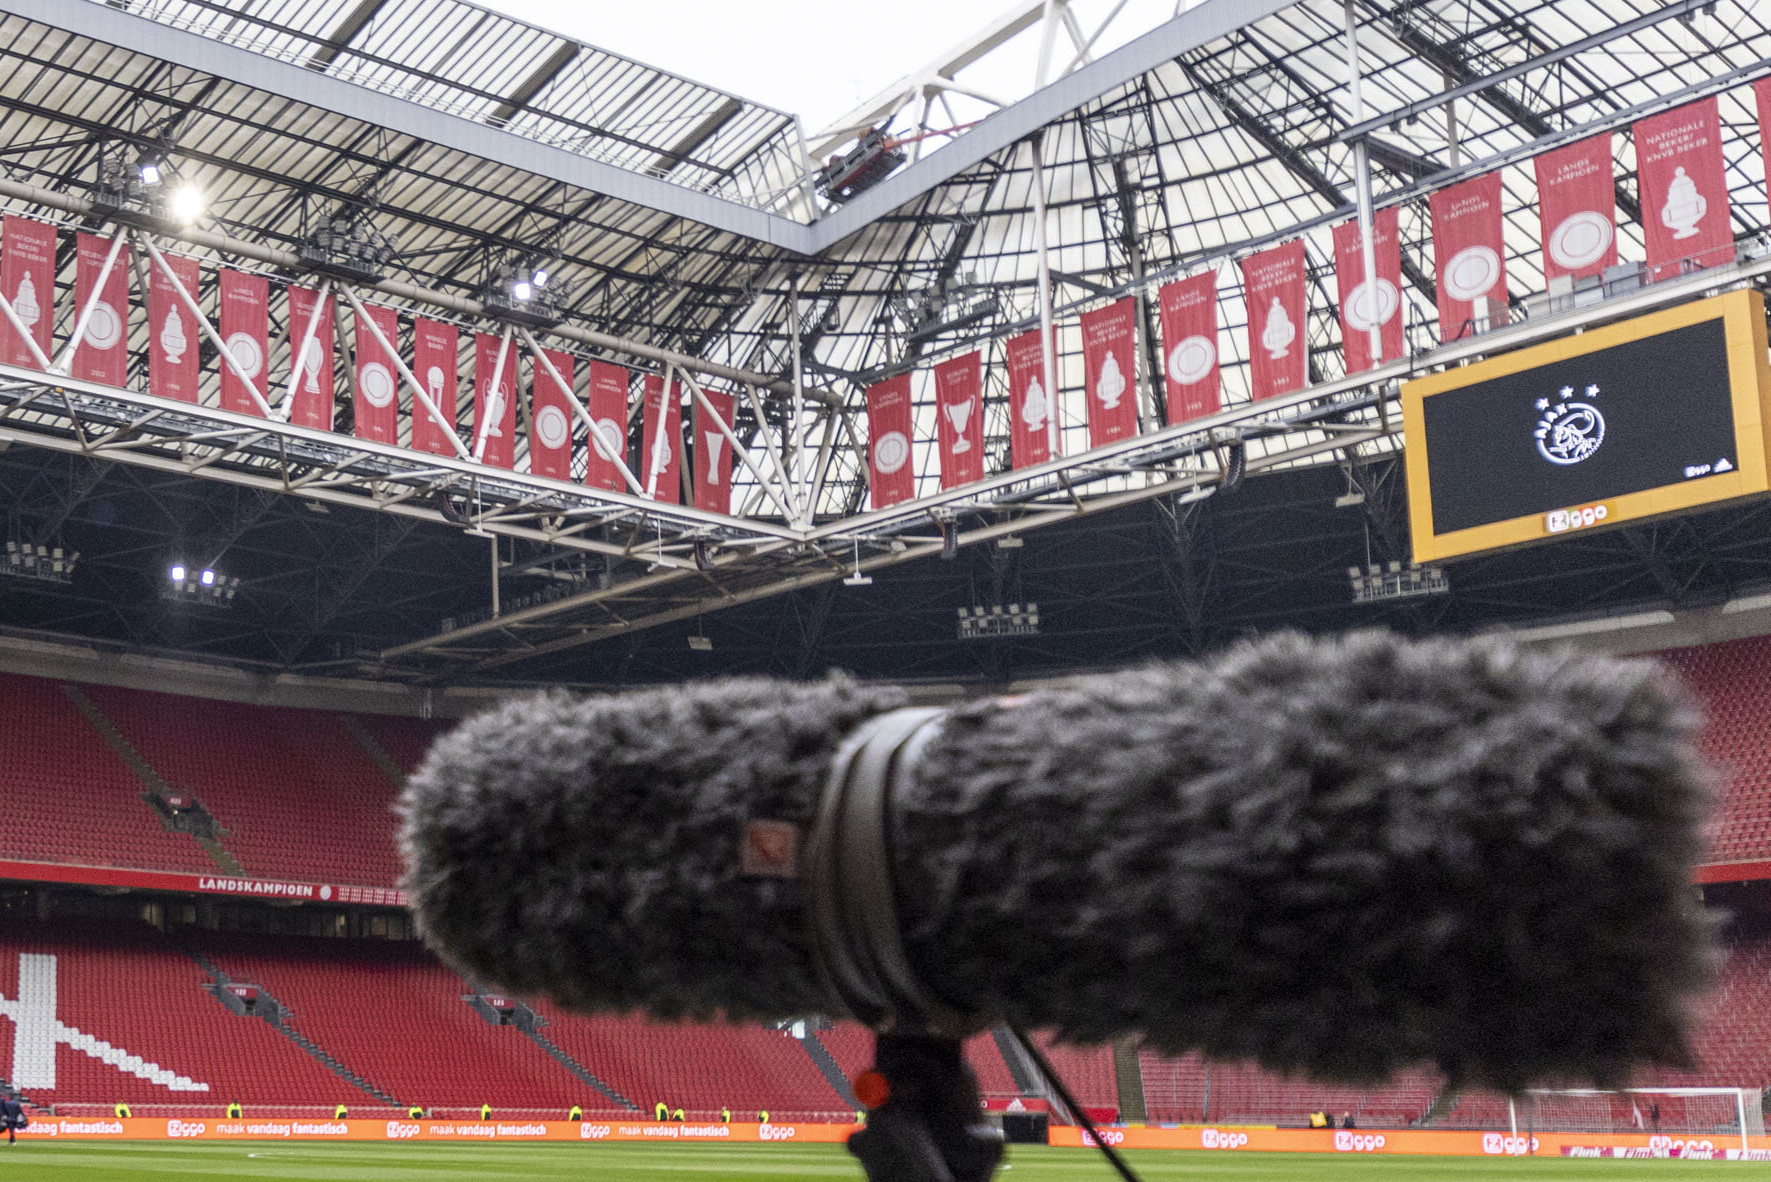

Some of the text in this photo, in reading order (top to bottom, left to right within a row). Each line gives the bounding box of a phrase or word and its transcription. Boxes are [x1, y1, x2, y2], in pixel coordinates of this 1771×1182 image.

[1646, 121, 1706, 145] NATIONALE
[198, 877, 314, 898] LANDSKAMPIOEN
[60, 1119, 124, 1135] fantastisch
[216, 1122, 245, 1135] maak
[247, 1122, 290, 1137] vandaag
[292, 1121, 349, 1136] fantastisch
[429, 1123, 455, 1135] maak
[457, 1124, 495, 1139] vandaag
[497, 1123, 547, 1136] fantastisch
[619, 1125, 641, 1136] maak
[643, 1125, 678, 1139] vandaag
[680, 1124, 730, 1137] fantastisch
